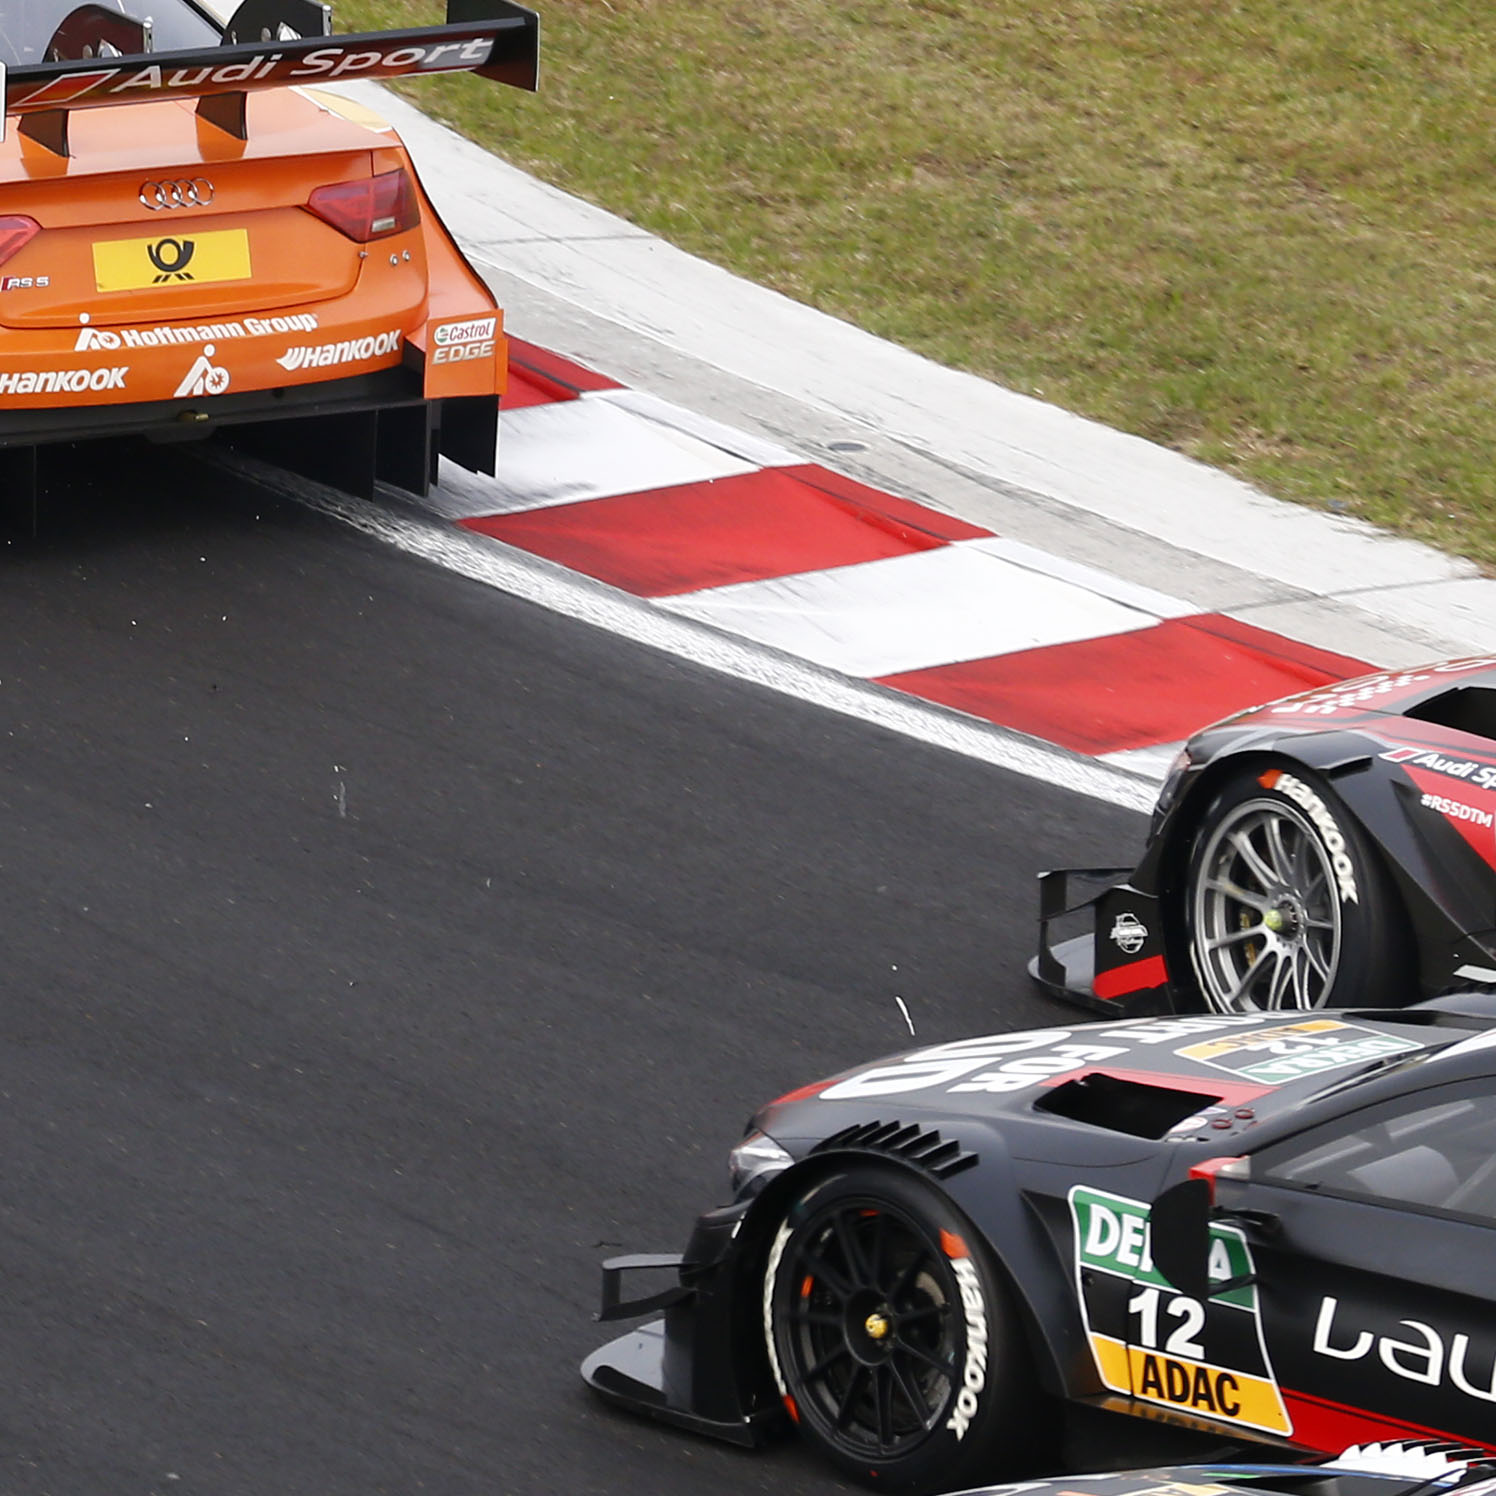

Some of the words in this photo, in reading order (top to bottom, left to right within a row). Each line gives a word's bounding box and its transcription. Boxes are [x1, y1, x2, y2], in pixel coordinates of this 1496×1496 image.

[108, 54, 286, 95] Audi
[289, 36, 496, 78] Sport
[123, 319, 246, 349] Hoffmann
[243, 312, 319, 336] Group
[448, 320, 493, 342] Castrol
[431, 339, 496, 366] EDGE
[1412, 753, 1480, 778] Audi
[1127, 1287, 1206, 1360] 12
[1140, 1353, 1241, 1417] ADAC
